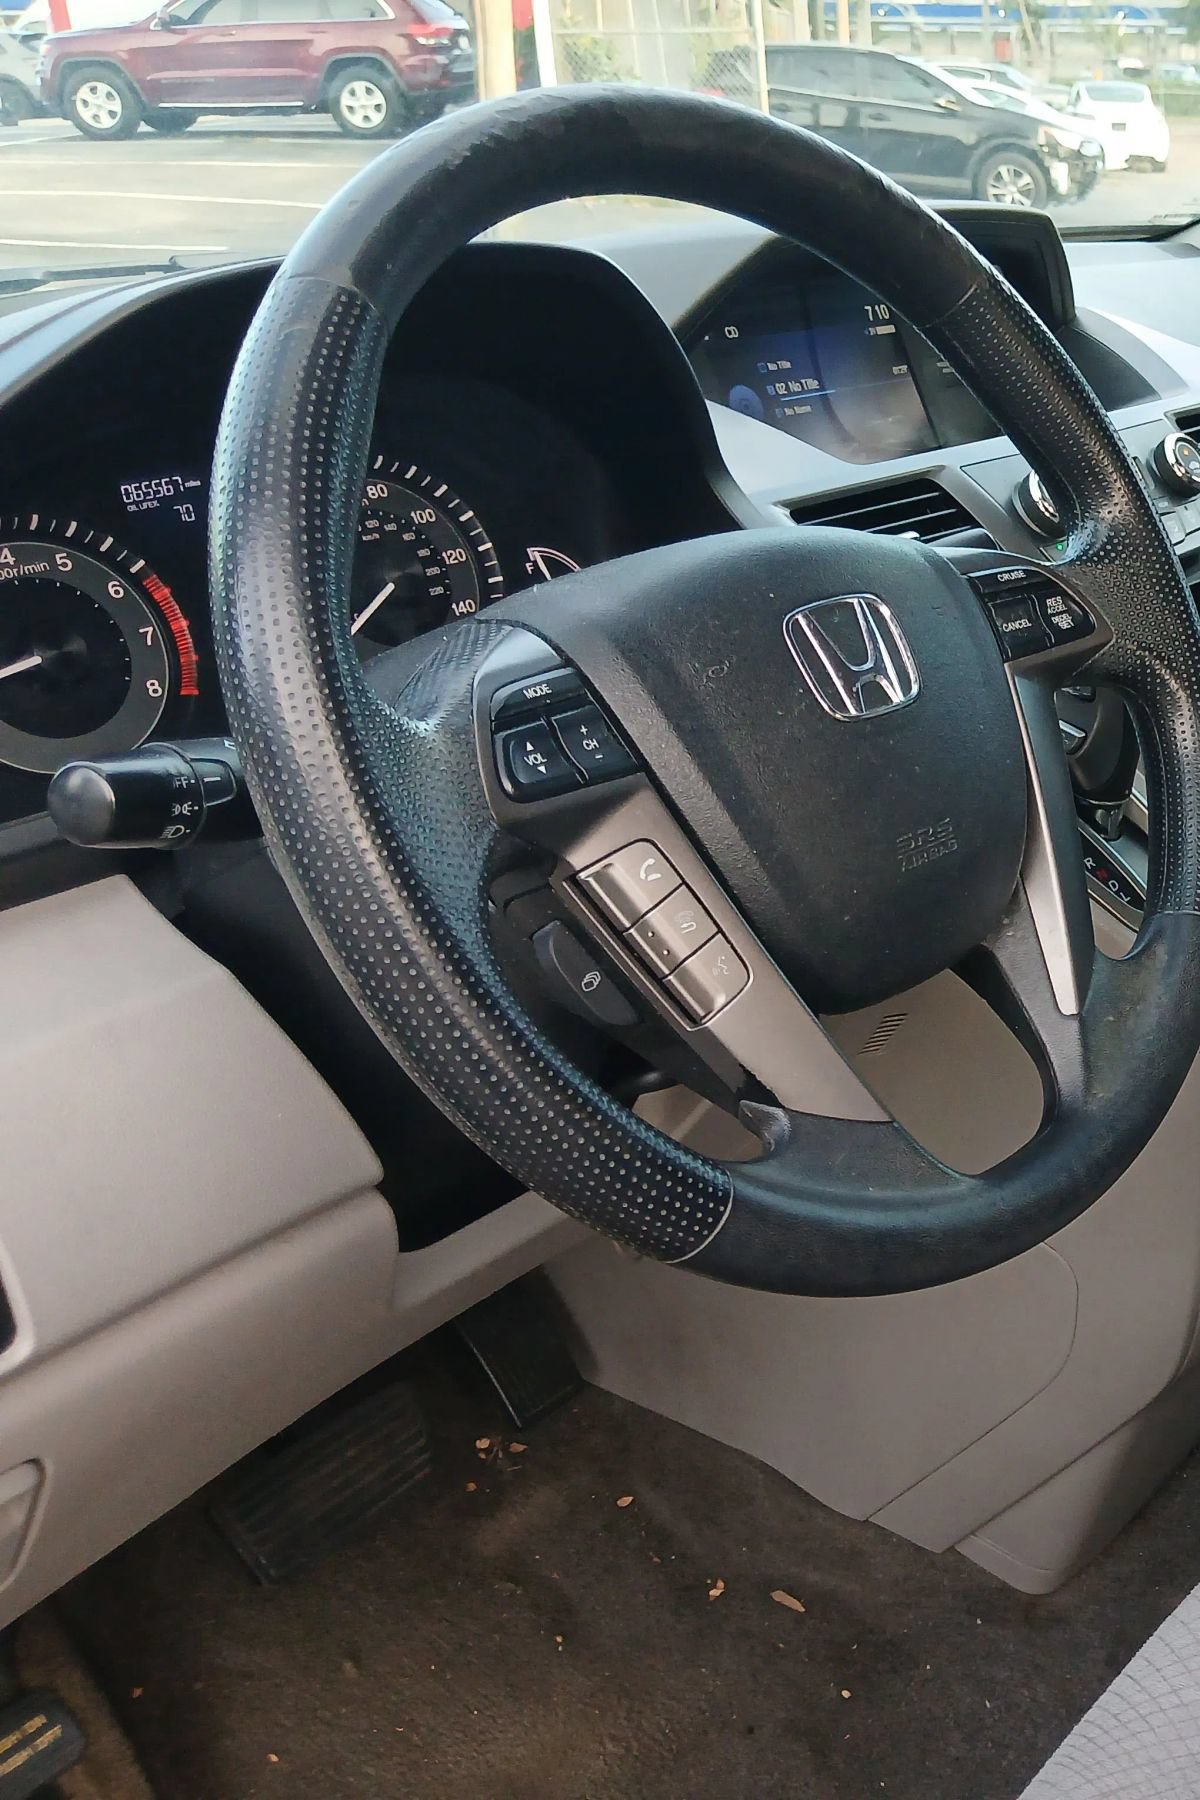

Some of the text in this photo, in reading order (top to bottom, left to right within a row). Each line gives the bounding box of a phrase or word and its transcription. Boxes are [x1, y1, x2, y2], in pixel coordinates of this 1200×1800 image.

[120, 476, 185, 503] 065567
[366, 483, 388, 499] 80
[173, 504, 196, 521] 70
[410, 508, 436, 524] 100
[0, 547, 16, 565] 4
[55, 552, 73, 572] 5
[441, 548, 467, 565] 120
[525, 562, 535, 575] F
[997, 570, 1027, 582] CRUISE
[107, 580, 125, 599] 6
[451, 599, 476, 617] 140
[1045, 596, 1063, 607] RES
[1002, 619, 1032, 632] CANCEL
[1058, 620, 1075, 630] SET
[138, 626, 154, 646] 7
[146, 679, 163, 697] 8
[522, 683, 553, 699] MODE
[582, 738, 600, 751] CH
[523, 752, 548, 766] VOL
[1083, 857, 1097, 870] R
[1108, 880, 1119, 892] D
[1119, 892, 1131, 902] L
